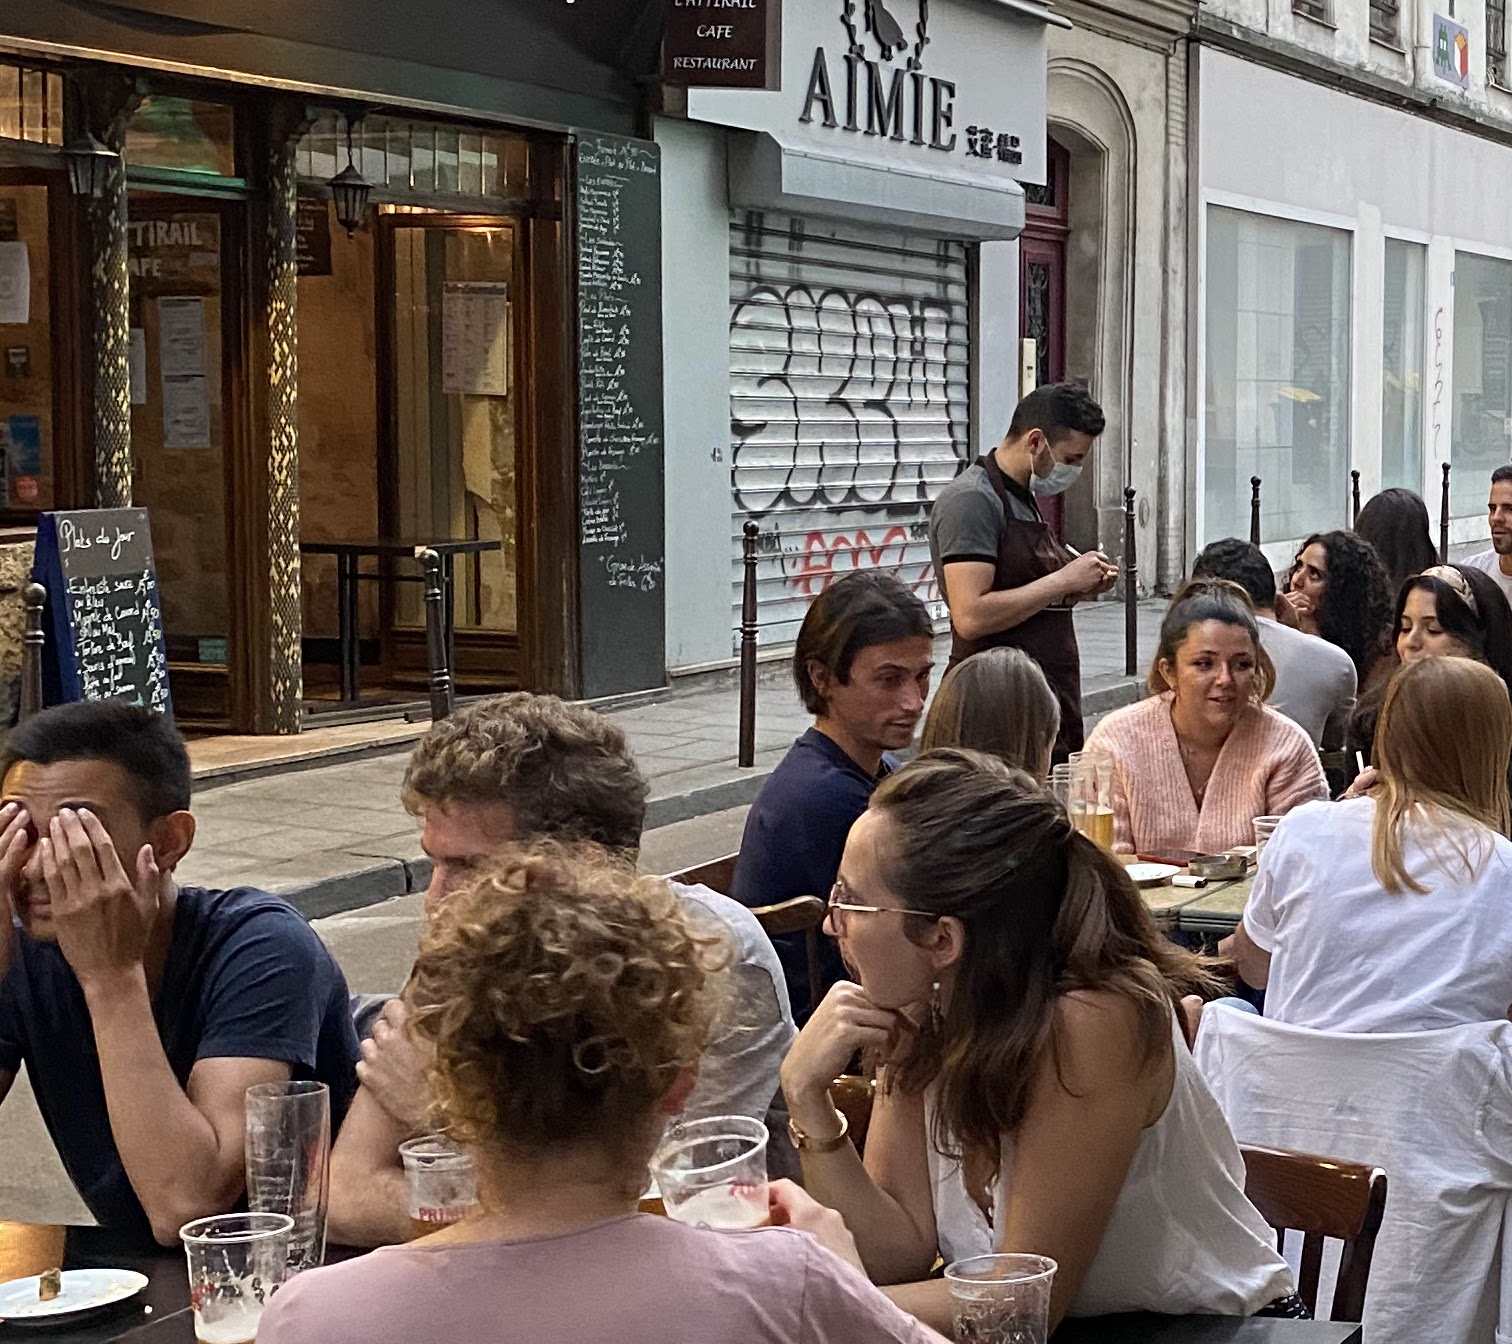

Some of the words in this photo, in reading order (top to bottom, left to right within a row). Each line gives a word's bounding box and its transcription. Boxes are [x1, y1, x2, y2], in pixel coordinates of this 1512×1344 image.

[696, 24, 734, 40] CAFE
[673, 56, 757, 72] RESTAURANT
[798, 46, 957, 152] AIMIE
[60, 519, 92, 553] Plats
[95, 526, 110, 544] du
